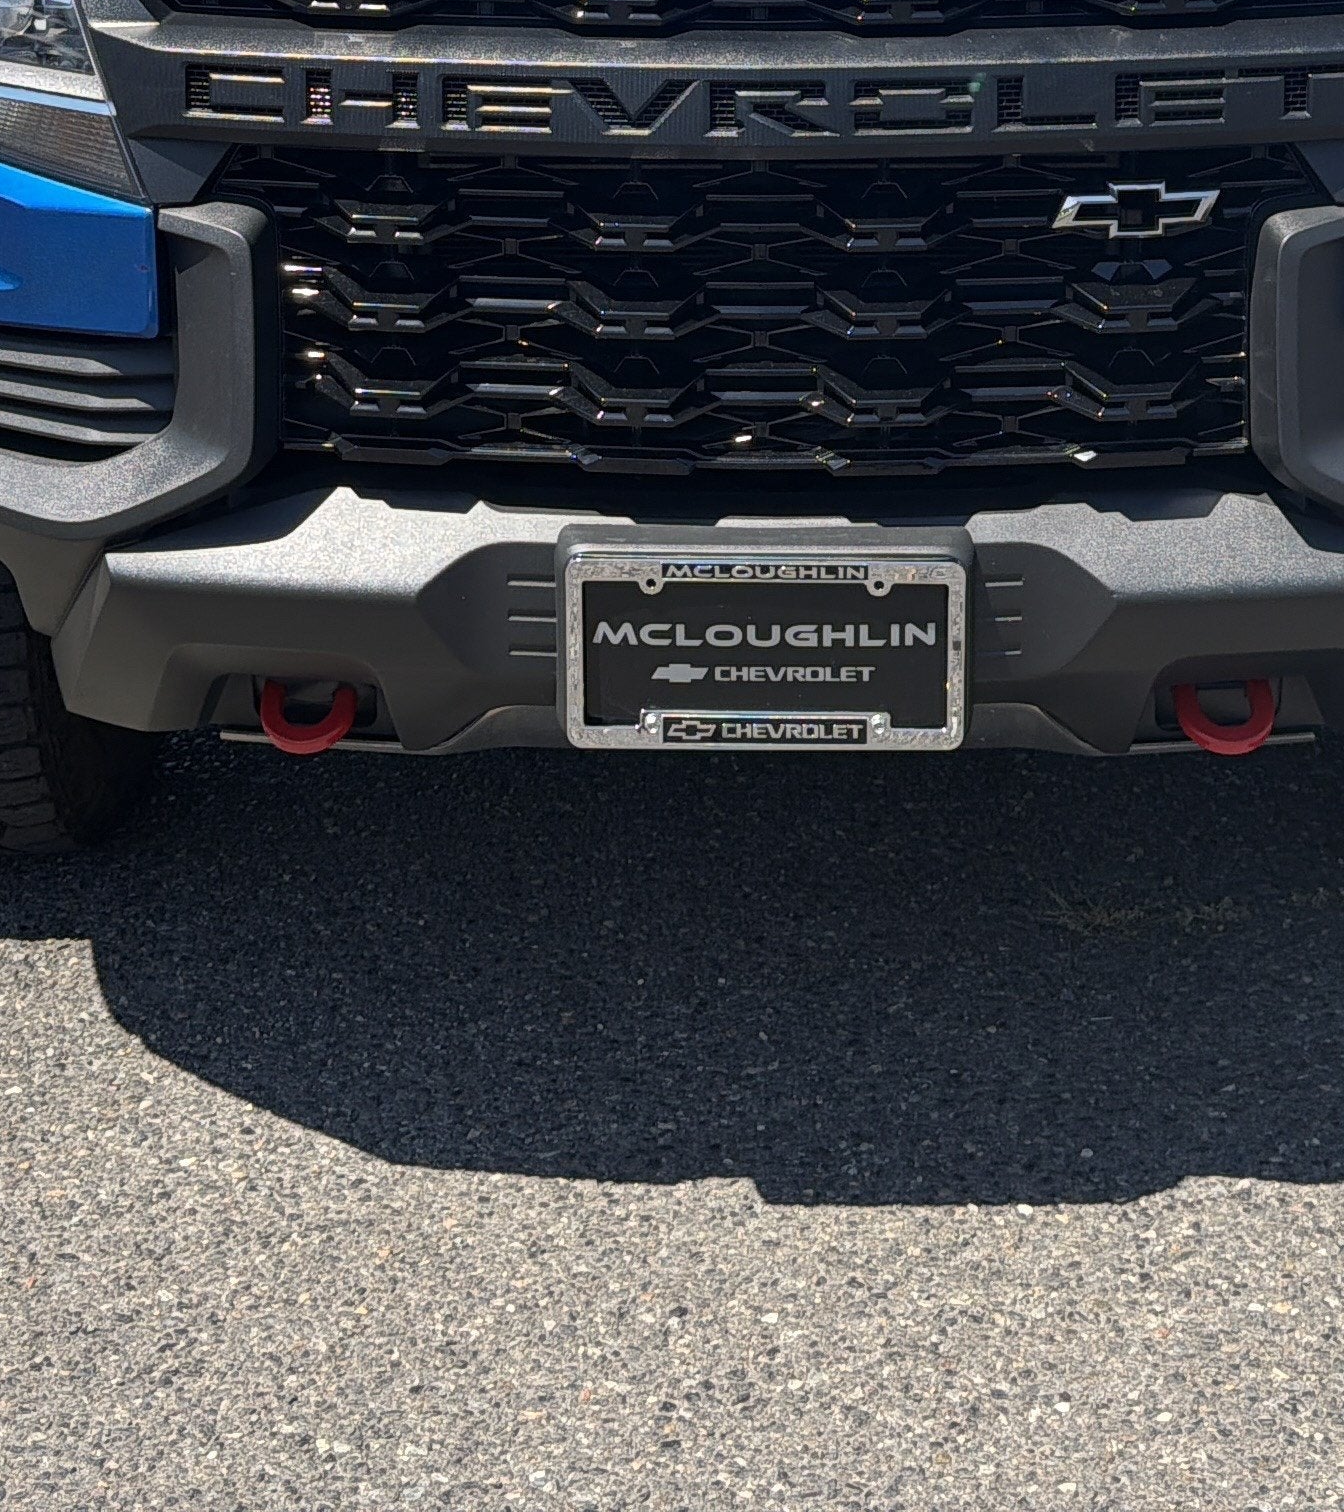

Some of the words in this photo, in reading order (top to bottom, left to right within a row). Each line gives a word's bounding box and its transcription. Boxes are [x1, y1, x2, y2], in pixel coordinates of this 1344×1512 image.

[665, 564, 866, 579] MCLOUGHLIN
[592, 621, 936, 648] MCLOUGHLIN
[714, 665, 875, 683] CHEVROLET
[721, 723, 864, 741] CHEVROLET
